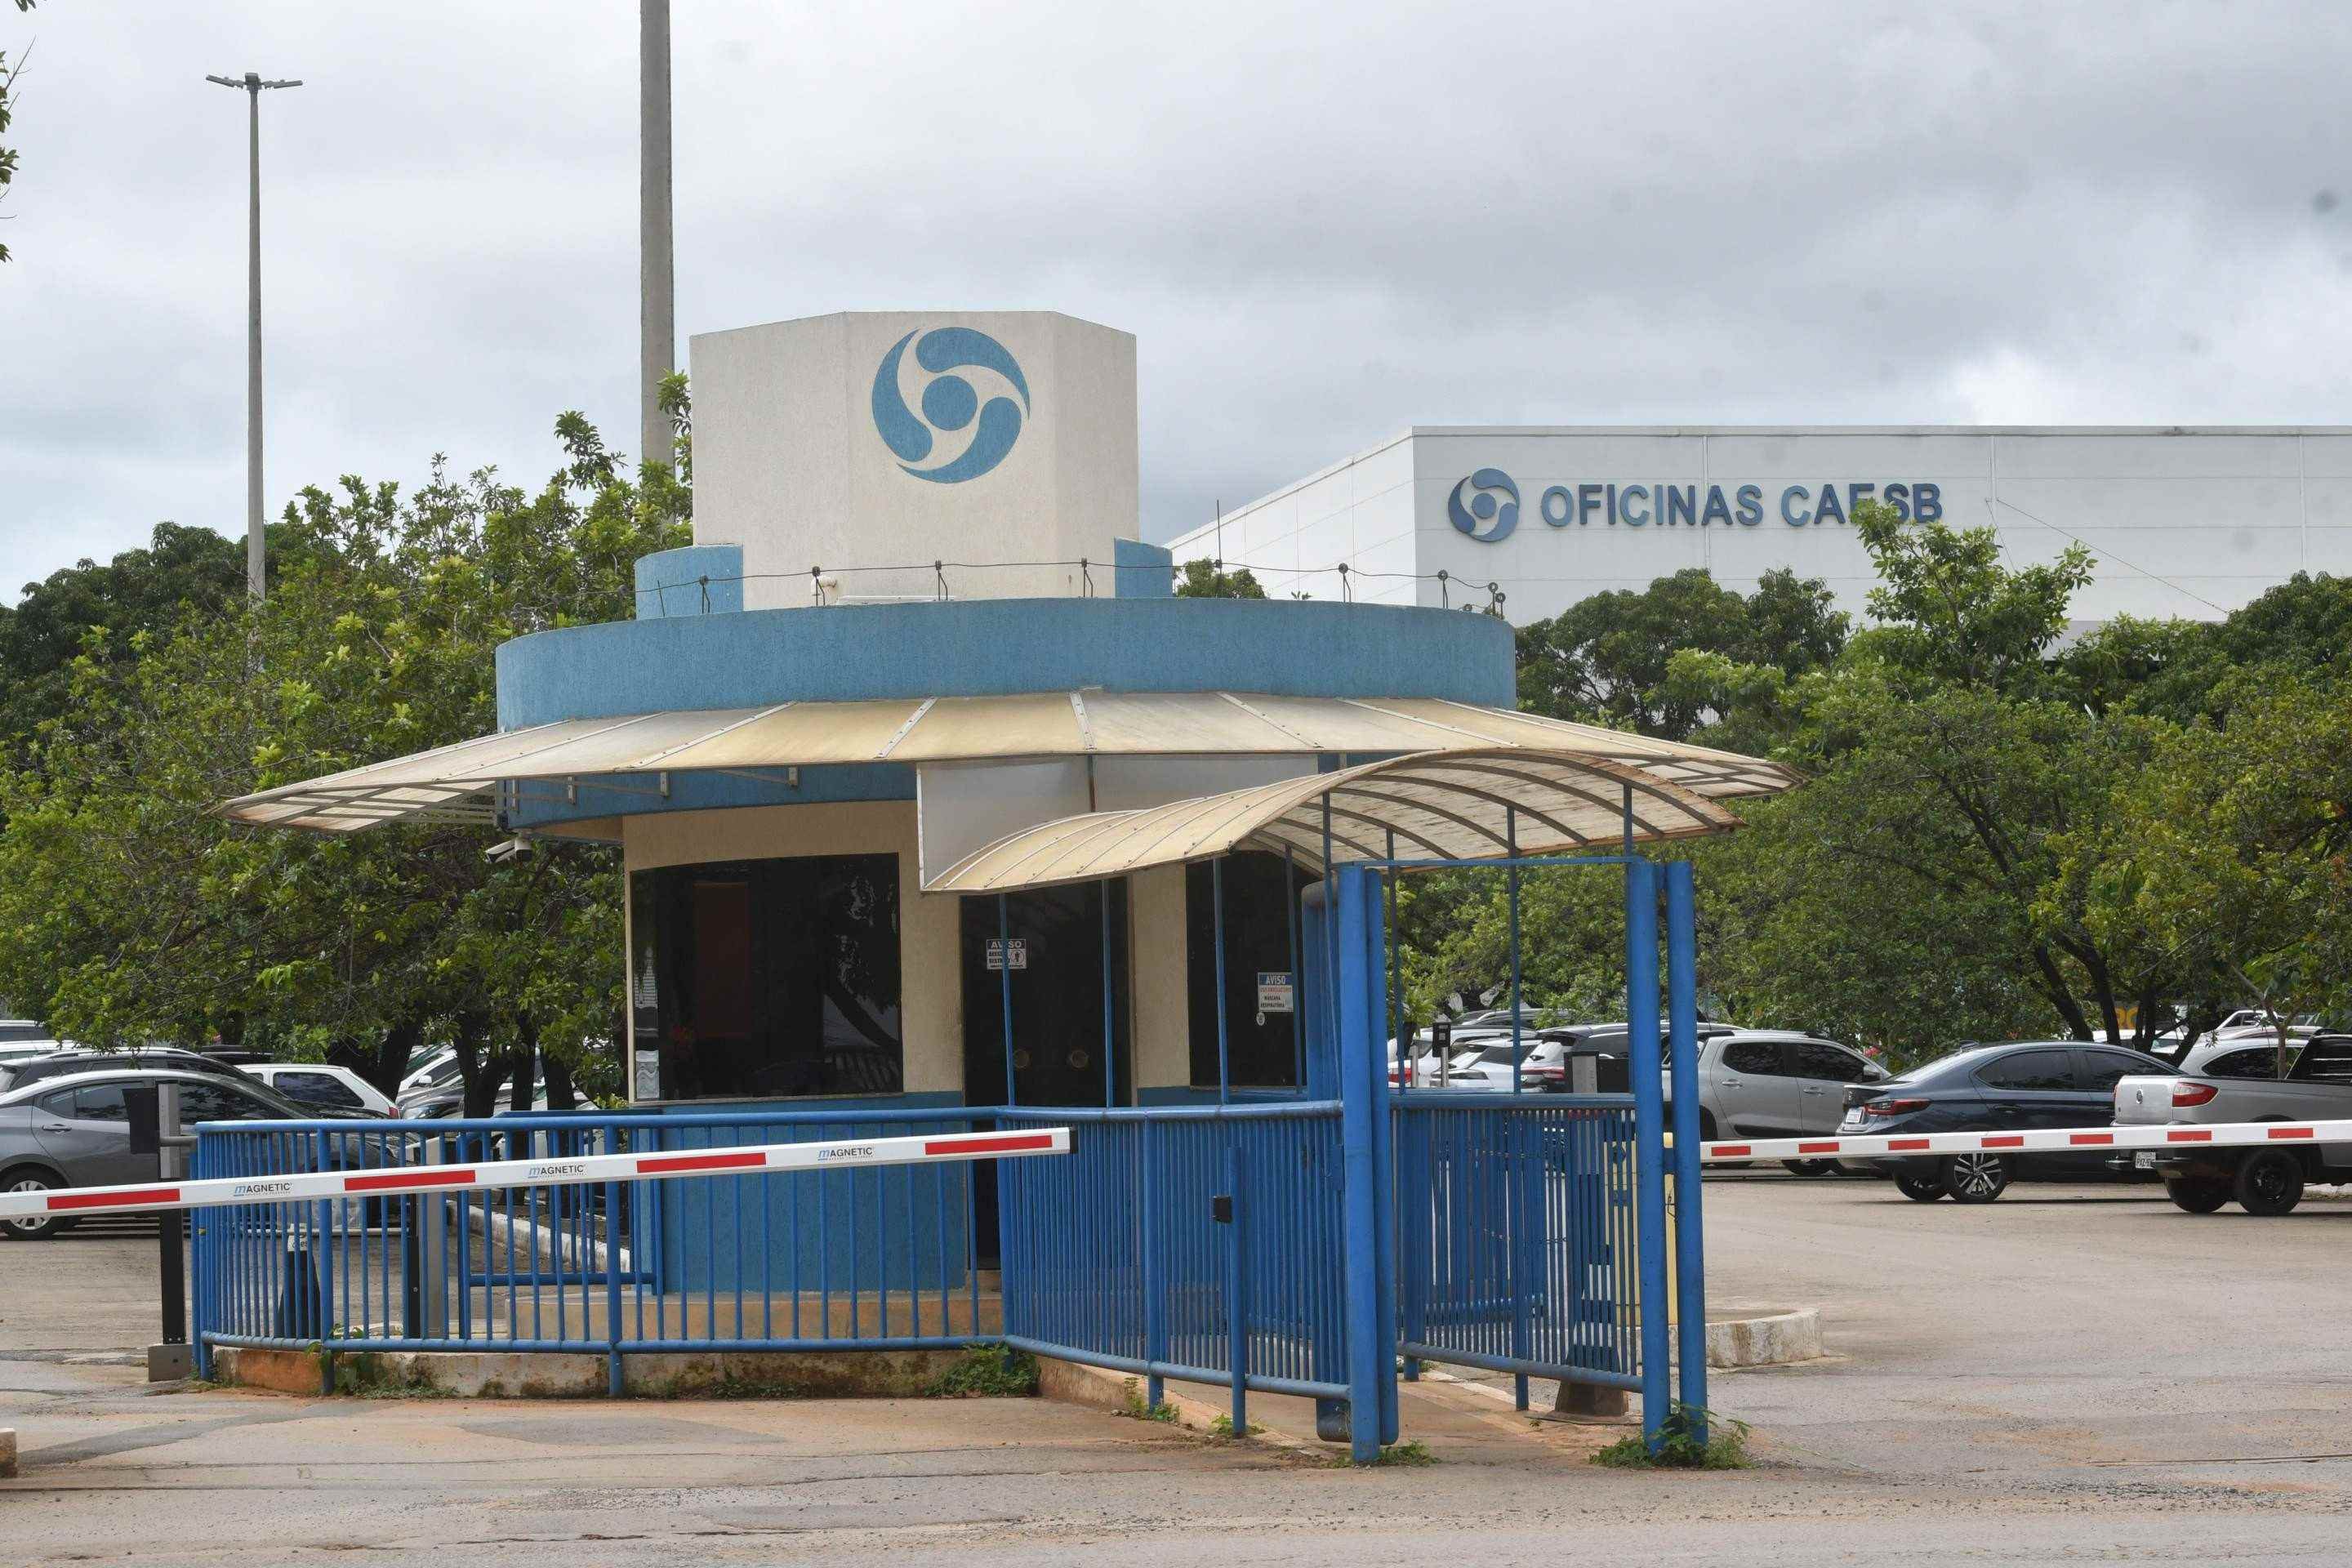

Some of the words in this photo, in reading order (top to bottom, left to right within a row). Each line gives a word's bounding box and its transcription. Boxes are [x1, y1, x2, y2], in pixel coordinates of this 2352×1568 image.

[1541, 483, 1764, 527] OFICINAS
[991, 940, 1022, 948] AVSO
[1266, 976, 1285, 984] AVISO
